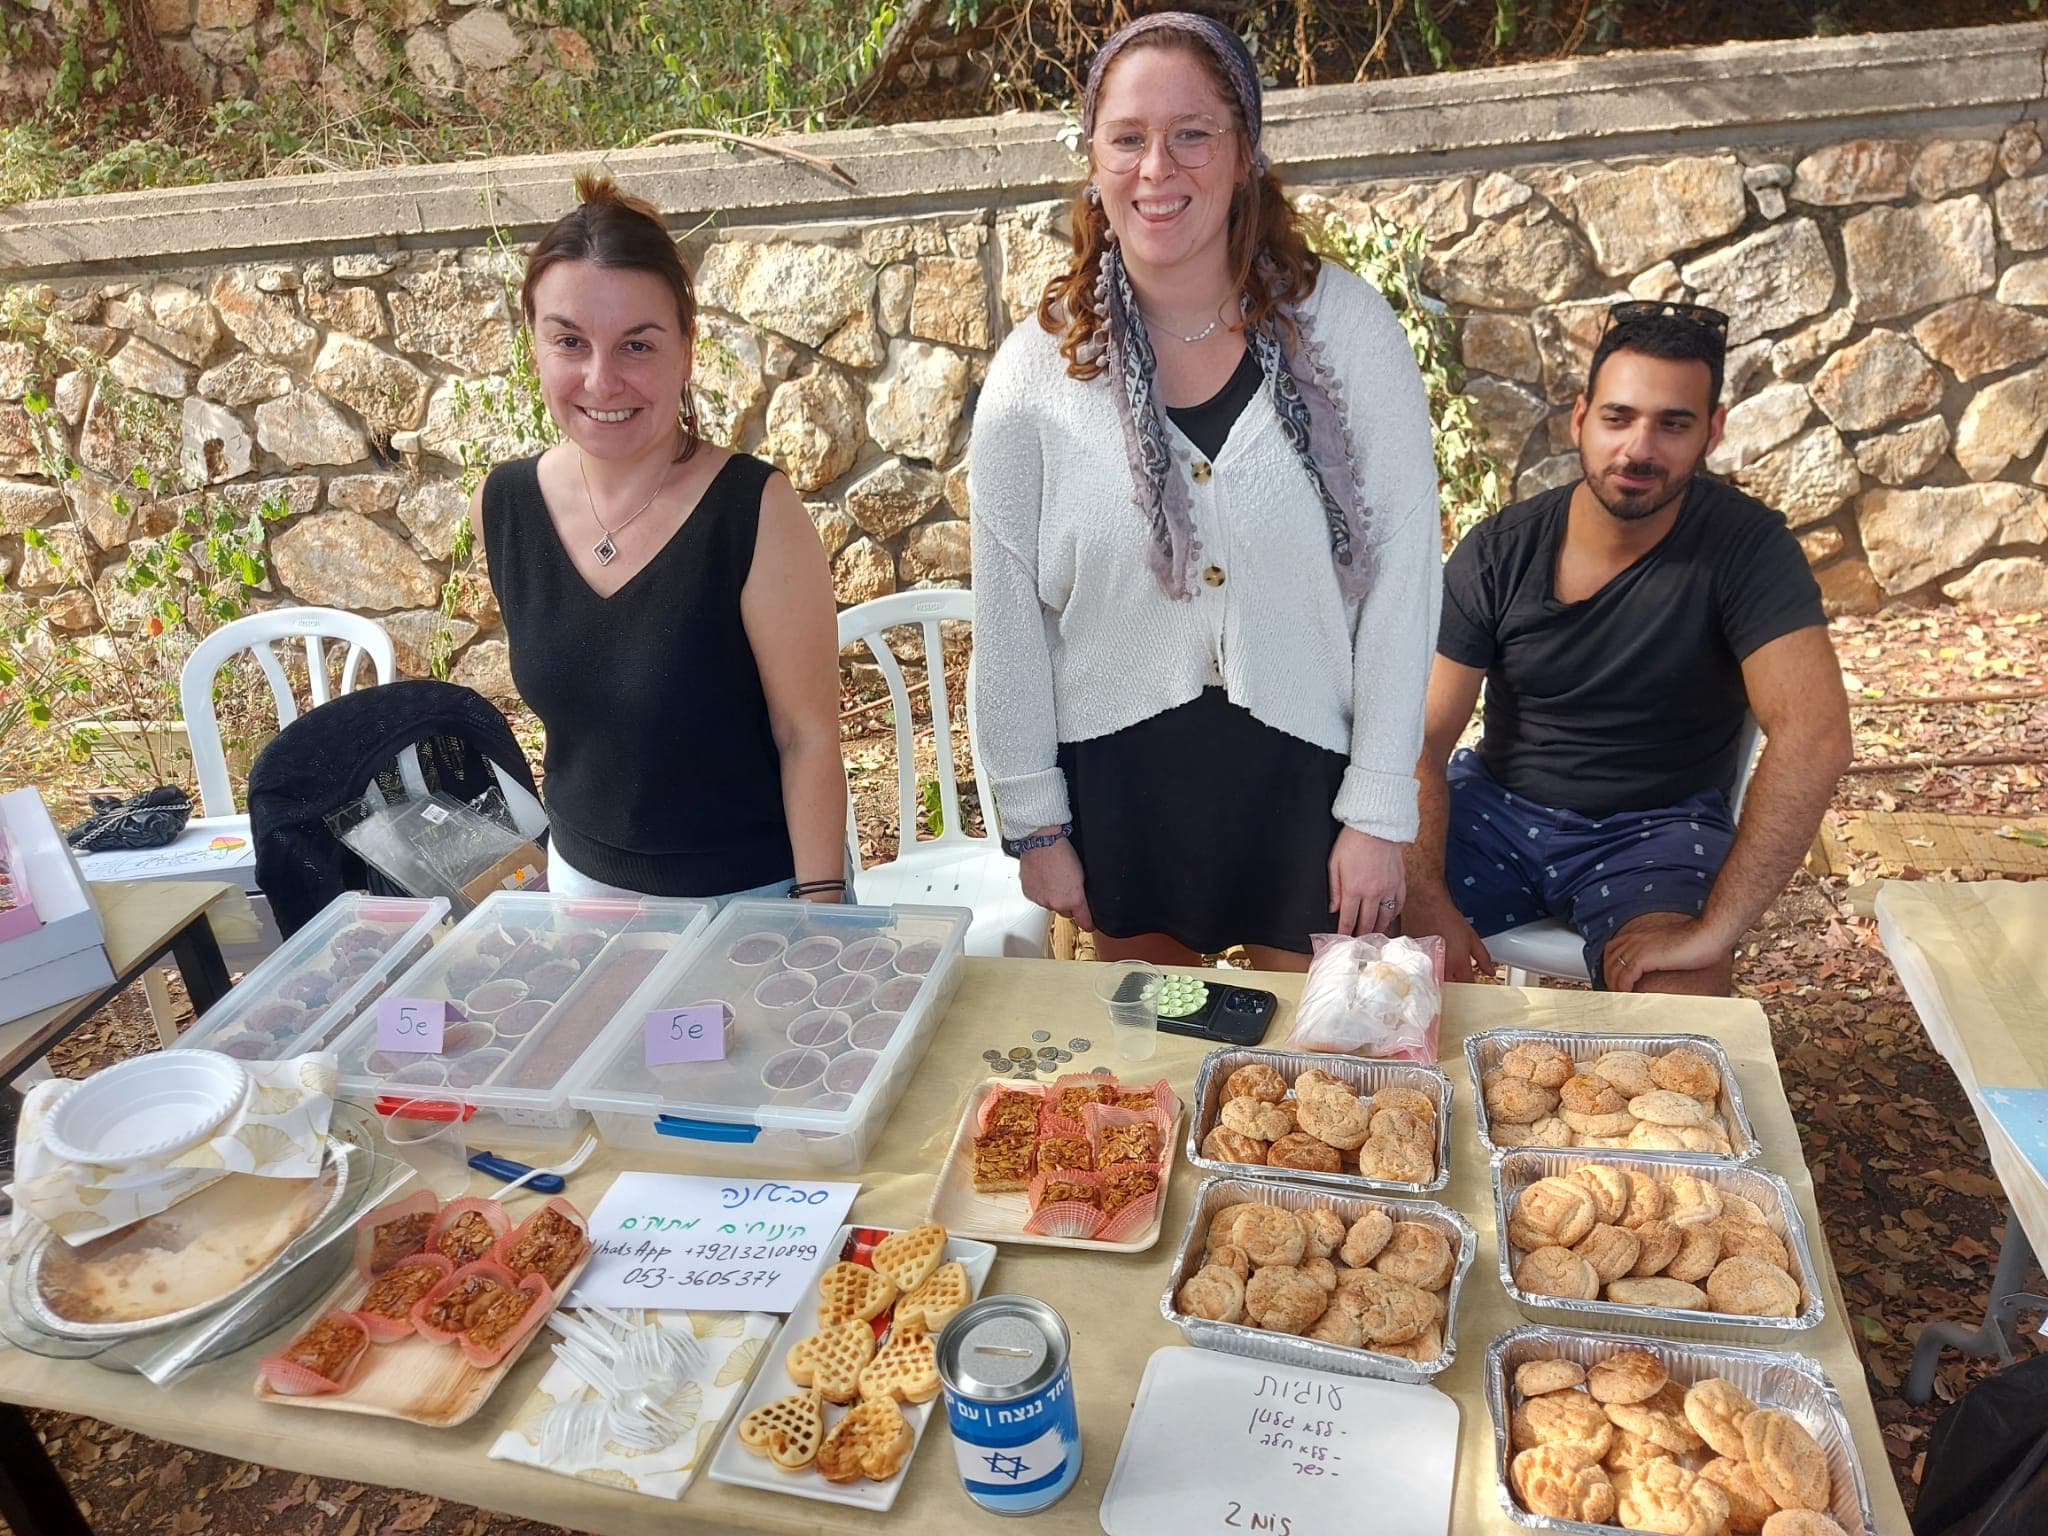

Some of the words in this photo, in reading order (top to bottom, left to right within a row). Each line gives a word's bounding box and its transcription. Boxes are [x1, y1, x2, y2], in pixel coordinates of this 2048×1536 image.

[720, 1182, 829, 1209] סבטלנה
[1253, 1375, 1345, 1411] עוגיות
[957, 1401, 979, 1420] עם
[998, 1399, 1043, 1424] ננצח
[1225, 1501, 1242, 1527] 2
